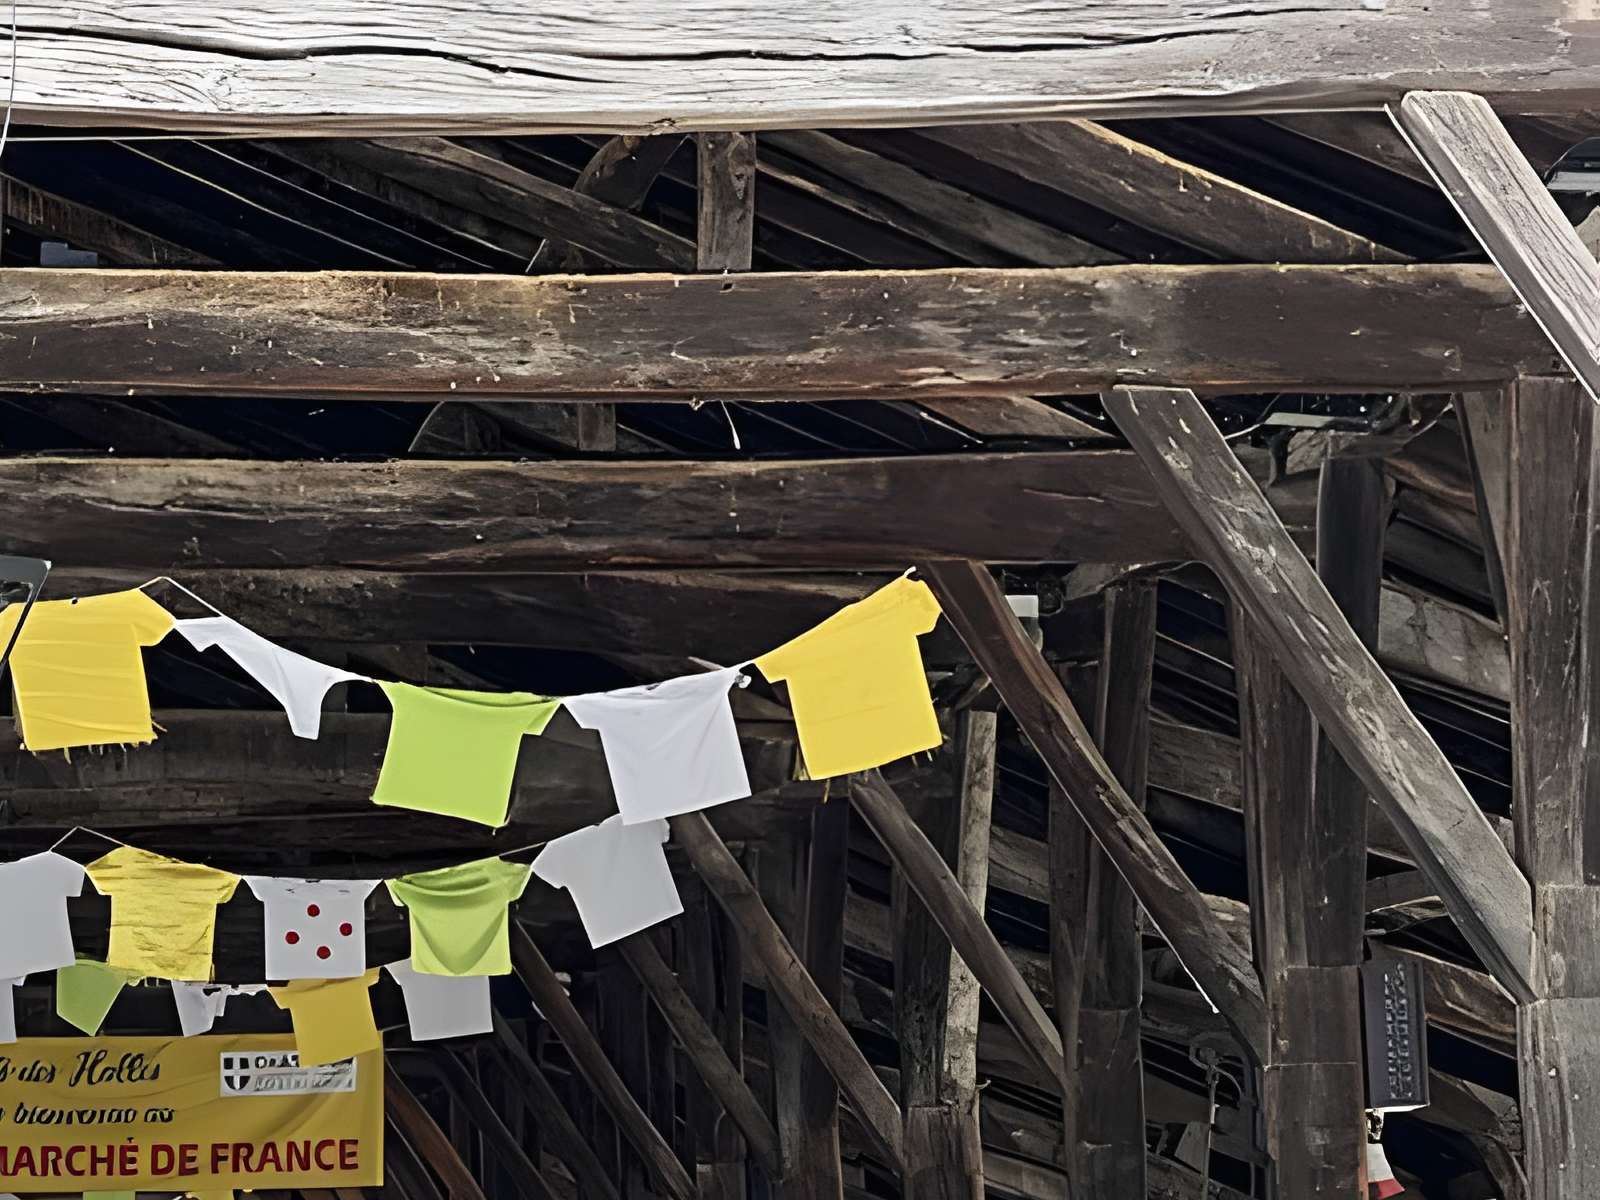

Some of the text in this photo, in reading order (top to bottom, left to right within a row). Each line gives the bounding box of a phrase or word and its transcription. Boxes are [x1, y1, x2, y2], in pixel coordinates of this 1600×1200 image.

[69, 1049, 161, 1088] Halles
[150, 1143, 200, 1177] DE
[210, 1138, 359, 1175] FRANCE
